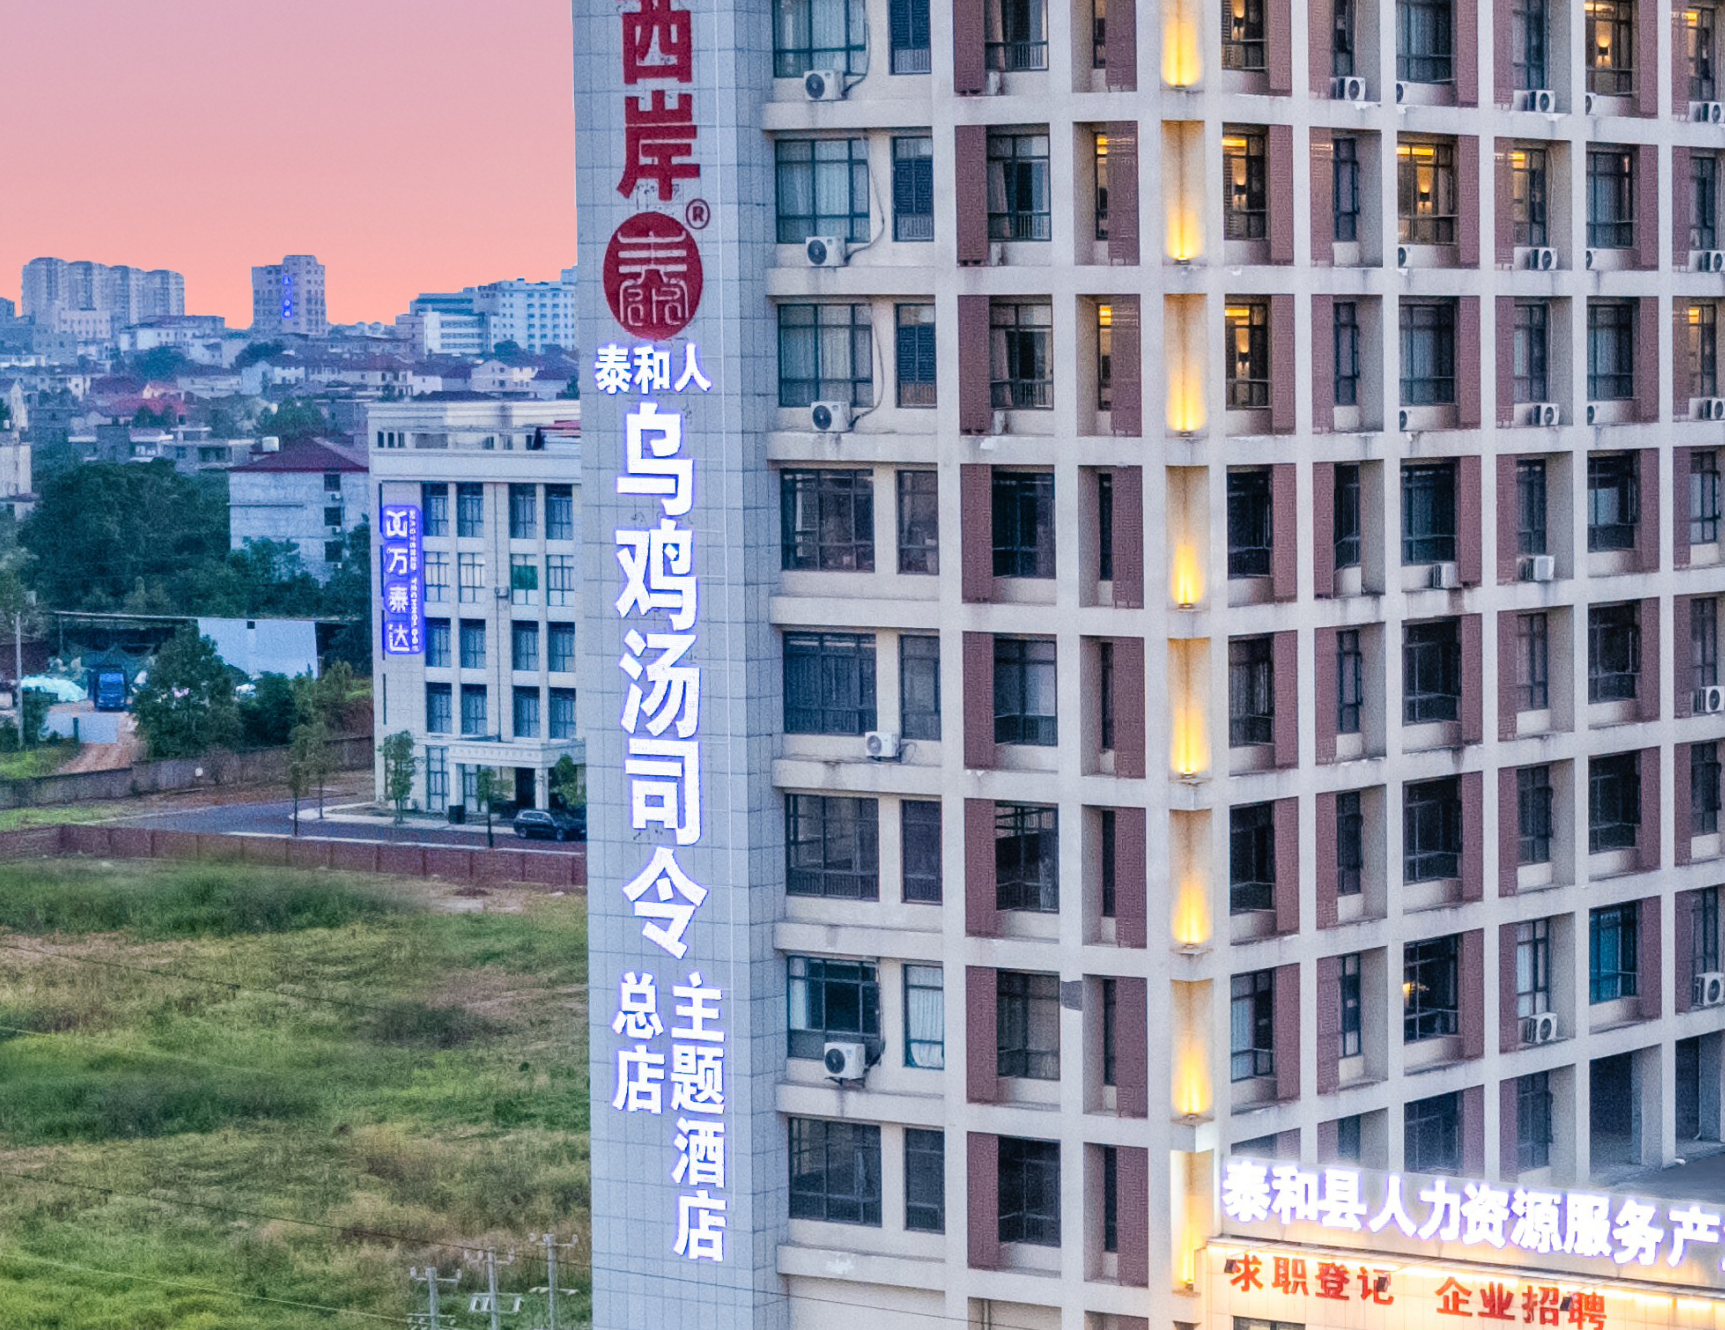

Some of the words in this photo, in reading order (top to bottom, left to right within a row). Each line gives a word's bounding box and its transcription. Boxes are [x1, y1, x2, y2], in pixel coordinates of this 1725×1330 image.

[595, 346, 712, 394] 泰和人
[615, 402, 707, 960] 乌鸡汤司令
[612, 972, 665, 1114] 总店
[670, 972, 727, 1263] 主题酒店
[1228, 1254, 1394, 1305] 求职登记
